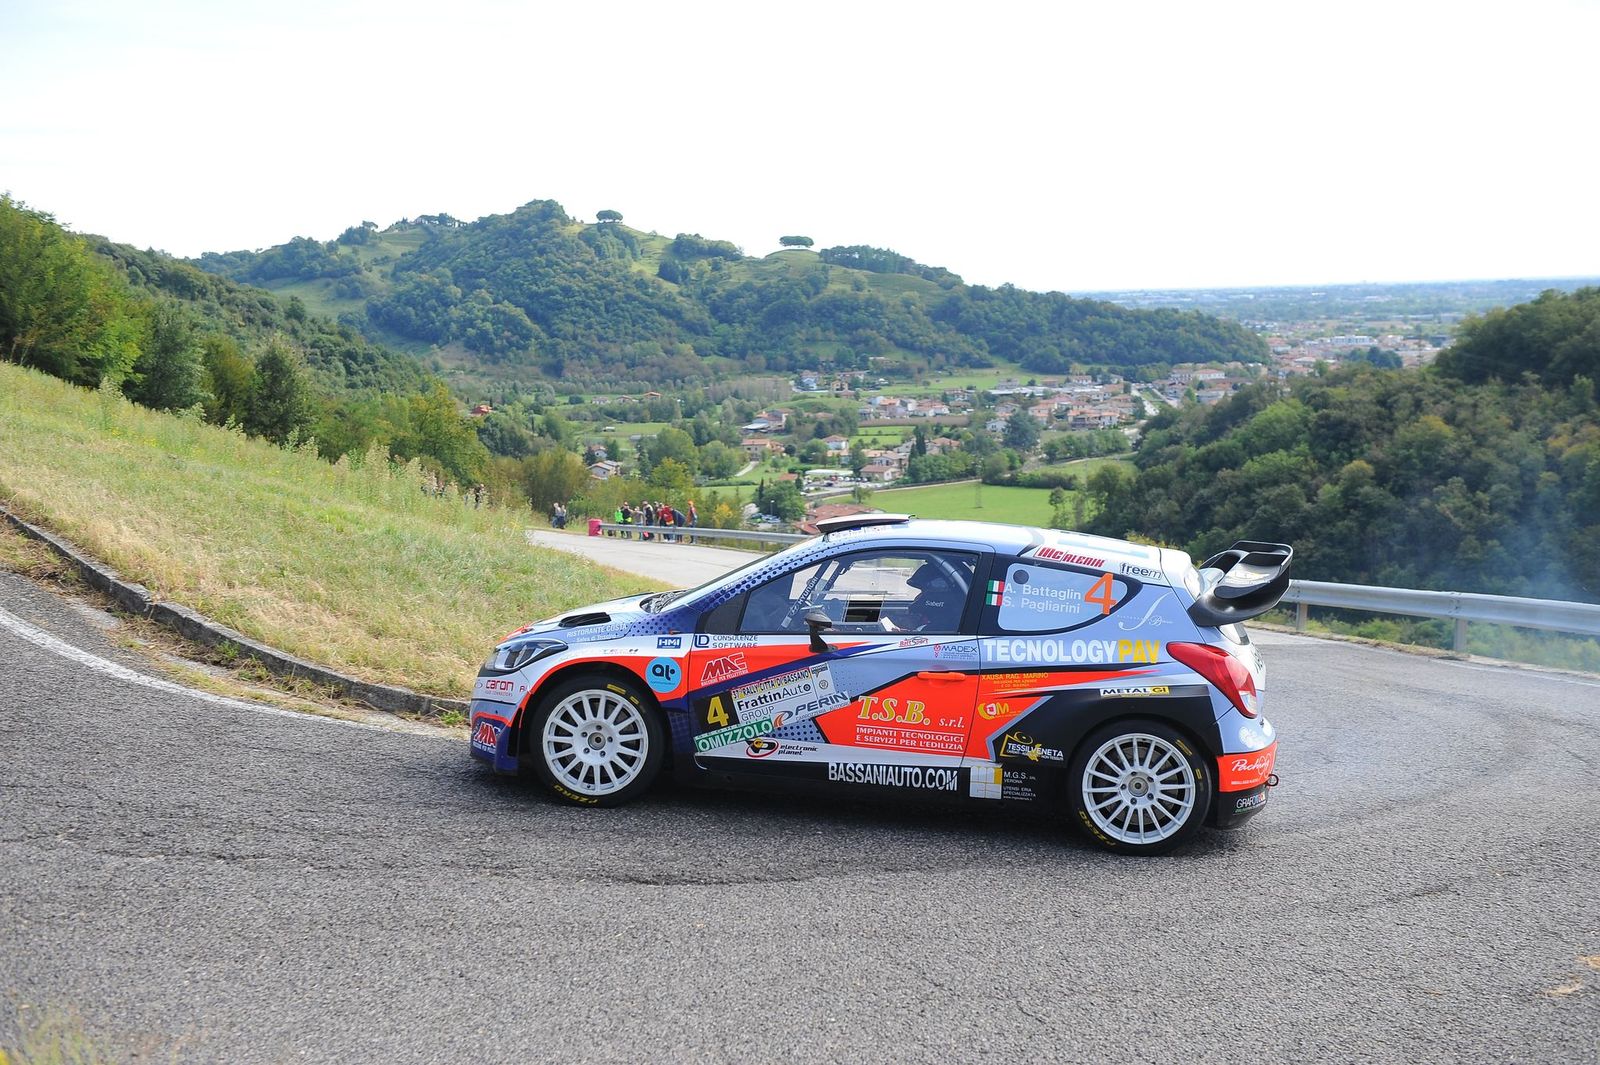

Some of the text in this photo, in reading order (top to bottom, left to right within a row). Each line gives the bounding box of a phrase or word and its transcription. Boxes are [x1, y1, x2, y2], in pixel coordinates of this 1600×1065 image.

[1120, 563, 1162, 580] freem
[797, 577, 819, 605] HYUNDAI
[1004, 584, 1082, 601] A. Battaglin
[1084, 571, 1118, 615] 4
[1002, 597, 1081, 615] S. Pagliarini
[658, 638, 680, 646] HMI
[941, 645, 978, 653] MADEX
[486, 679, 514, 691] caron
[743, 685, 760, 696] RALLY
[783, 669, 810, 684] BASSANO
[981, 673, 1004, 681] XAUSA
[1103, 687, 1149, 695] METAL
[706, 696, 729, 727] 4
[795, 692, 849, 715] PERIN
[857, 695, 931, 726] T.S.B.
[740, 705, 774, 722] GROUP
[938, 717, 966, 729] s.r.l.
[698, 720, 773, 752] OMIZZOLO
[856, 726, 964, 744] IMPIANTI TECNOLOGICI
[863, 735, 897, 745] SERVIZI
[899, 739, 917, 747] PER
[919, 740, 964, 751] L'EDILIZIA
[780, 744, 819, 752] electronic
[1007, 742, 1064, 758] TESSILVENETA
[828, 762, 958, 792] BASSANIAUTO.COM
